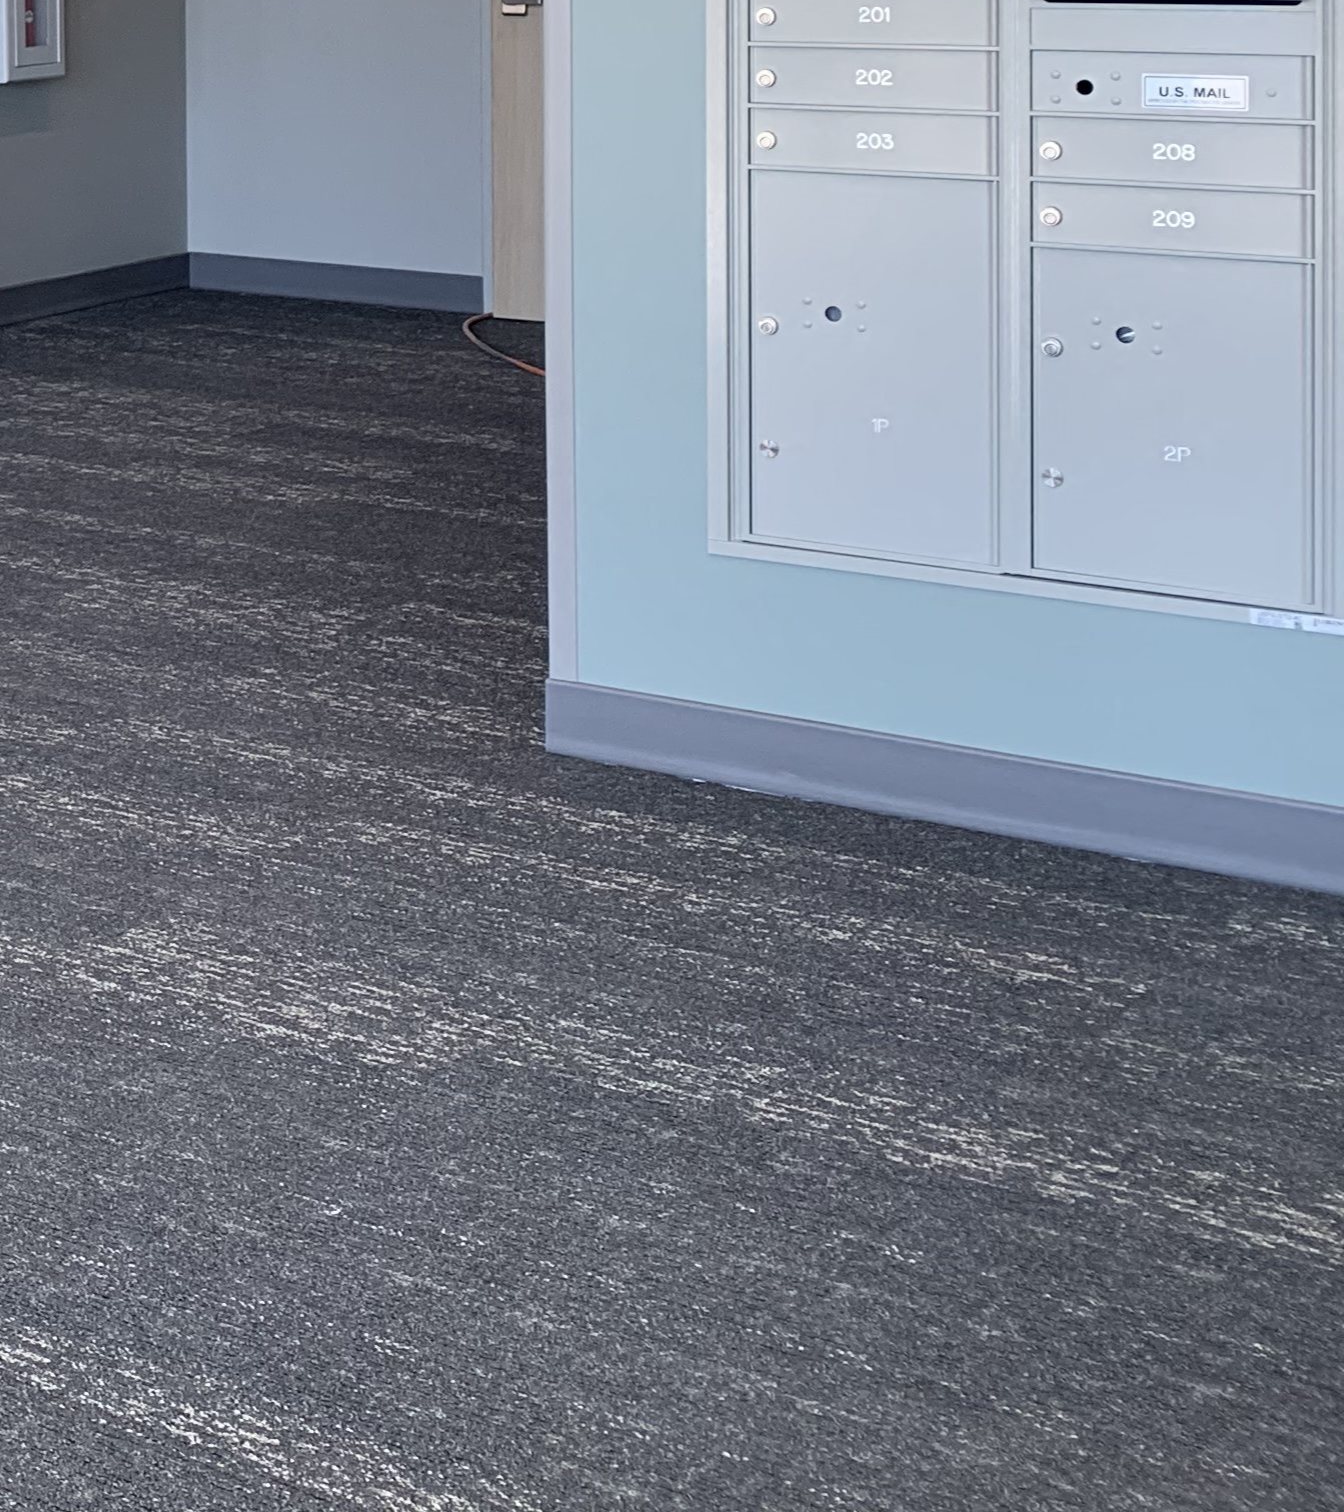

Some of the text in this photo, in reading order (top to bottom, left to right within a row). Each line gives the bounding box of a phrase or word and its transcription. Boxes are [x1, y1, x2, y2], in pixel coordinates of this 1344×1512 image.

[858, 7, 890, 23] 201
[856, 70, 894, 86] 202
[1159, 86, 1231, 99] U.S. MAIL
[856, 133, 894, 150] 203
[1152, 143, 1196, 161] 208
[1152, 210, 1195, 228] 209
[872, 418, 889, 433] 1P
[1163, 445, 1192, 462] 2P
